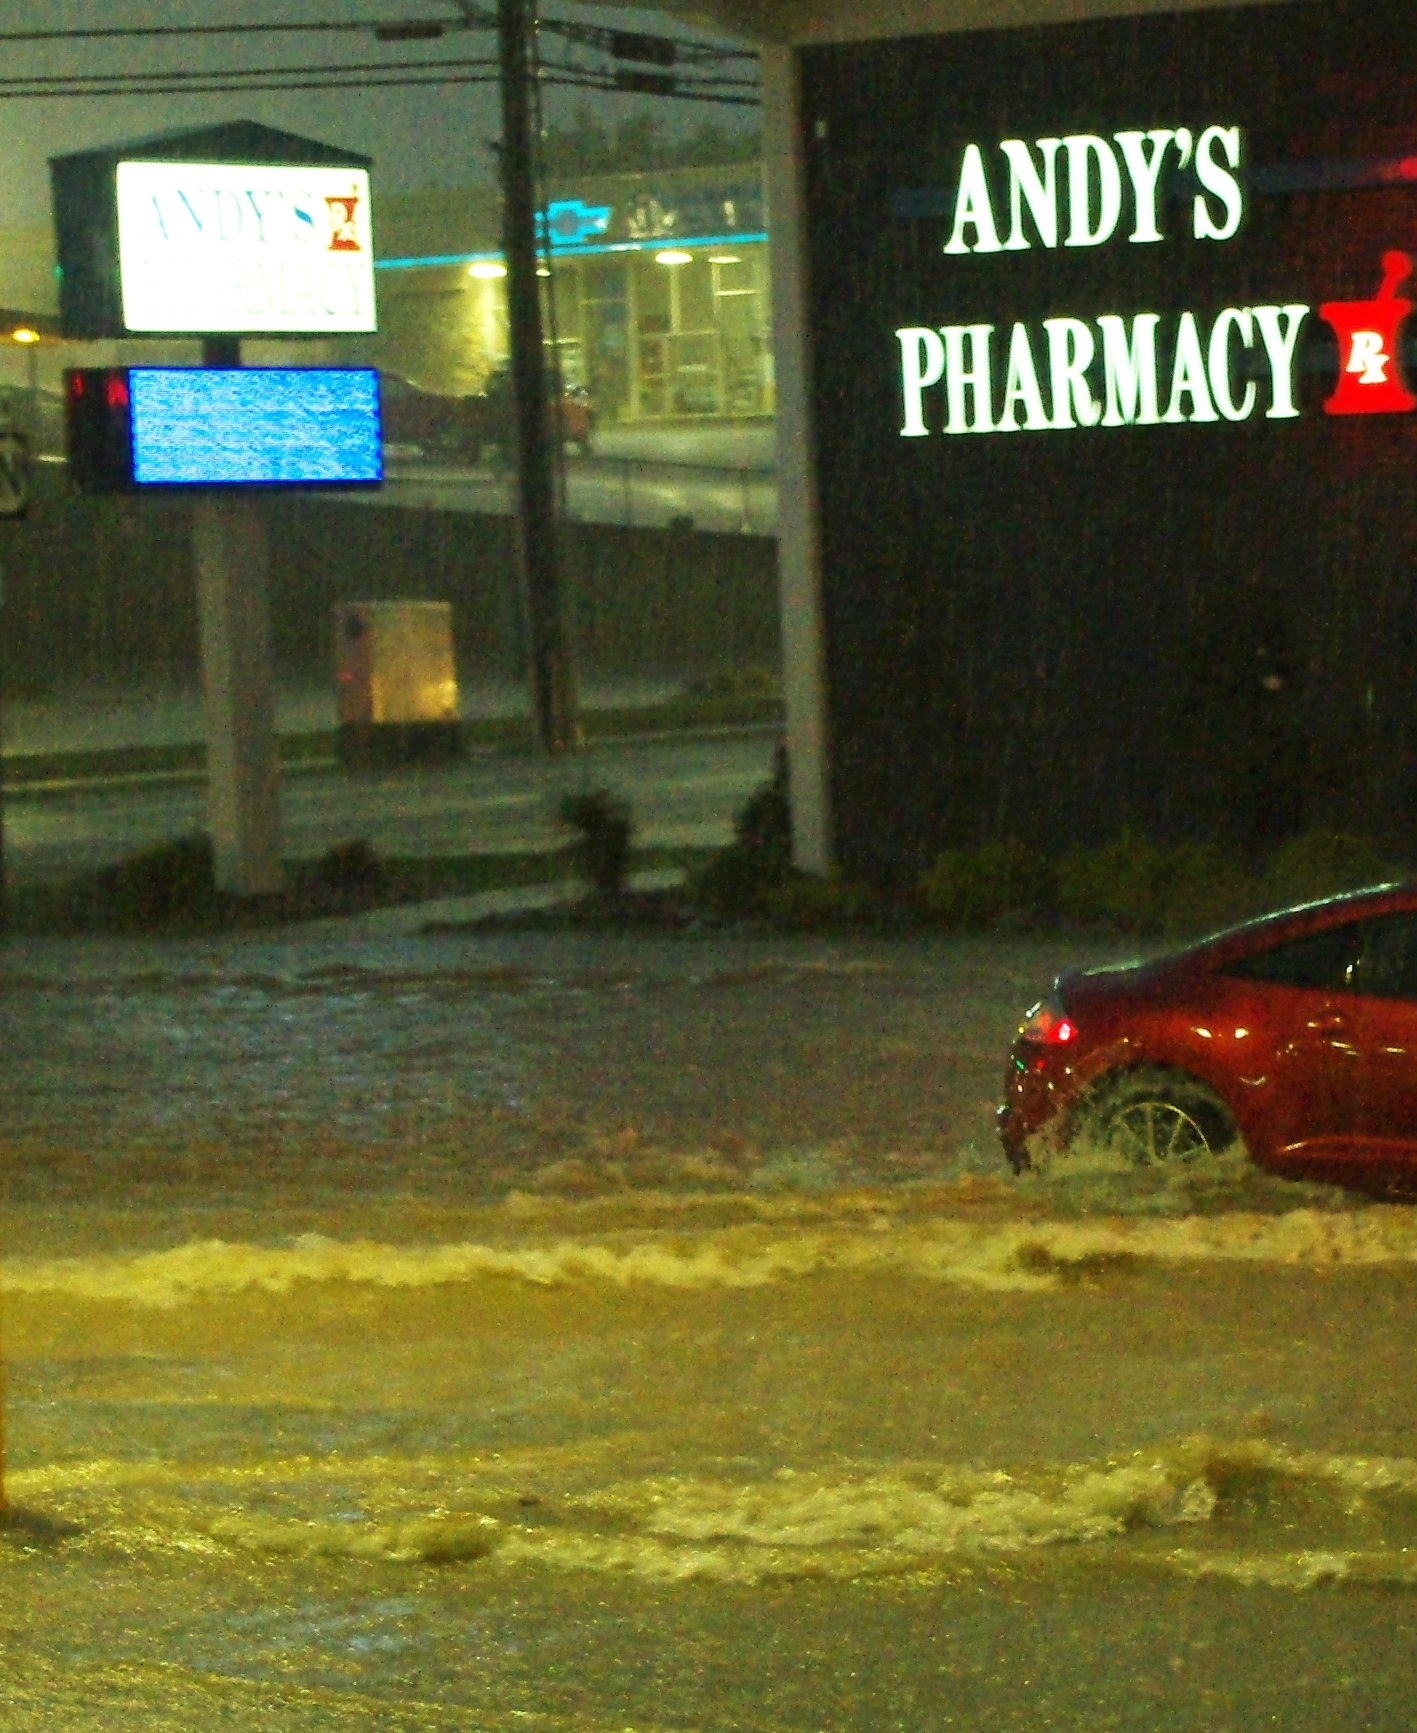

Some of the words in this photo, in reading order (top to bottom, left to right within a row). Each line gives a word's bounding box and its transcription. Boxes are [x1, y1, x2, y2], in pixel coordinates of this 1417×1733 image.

[140, 187, 316, 243] ANDY'S
[943, 126, 1243, 254] ANDY'S
[143, 259, 368, 316] RMACY
[895, 304, 1310, 438] PHARMACY
